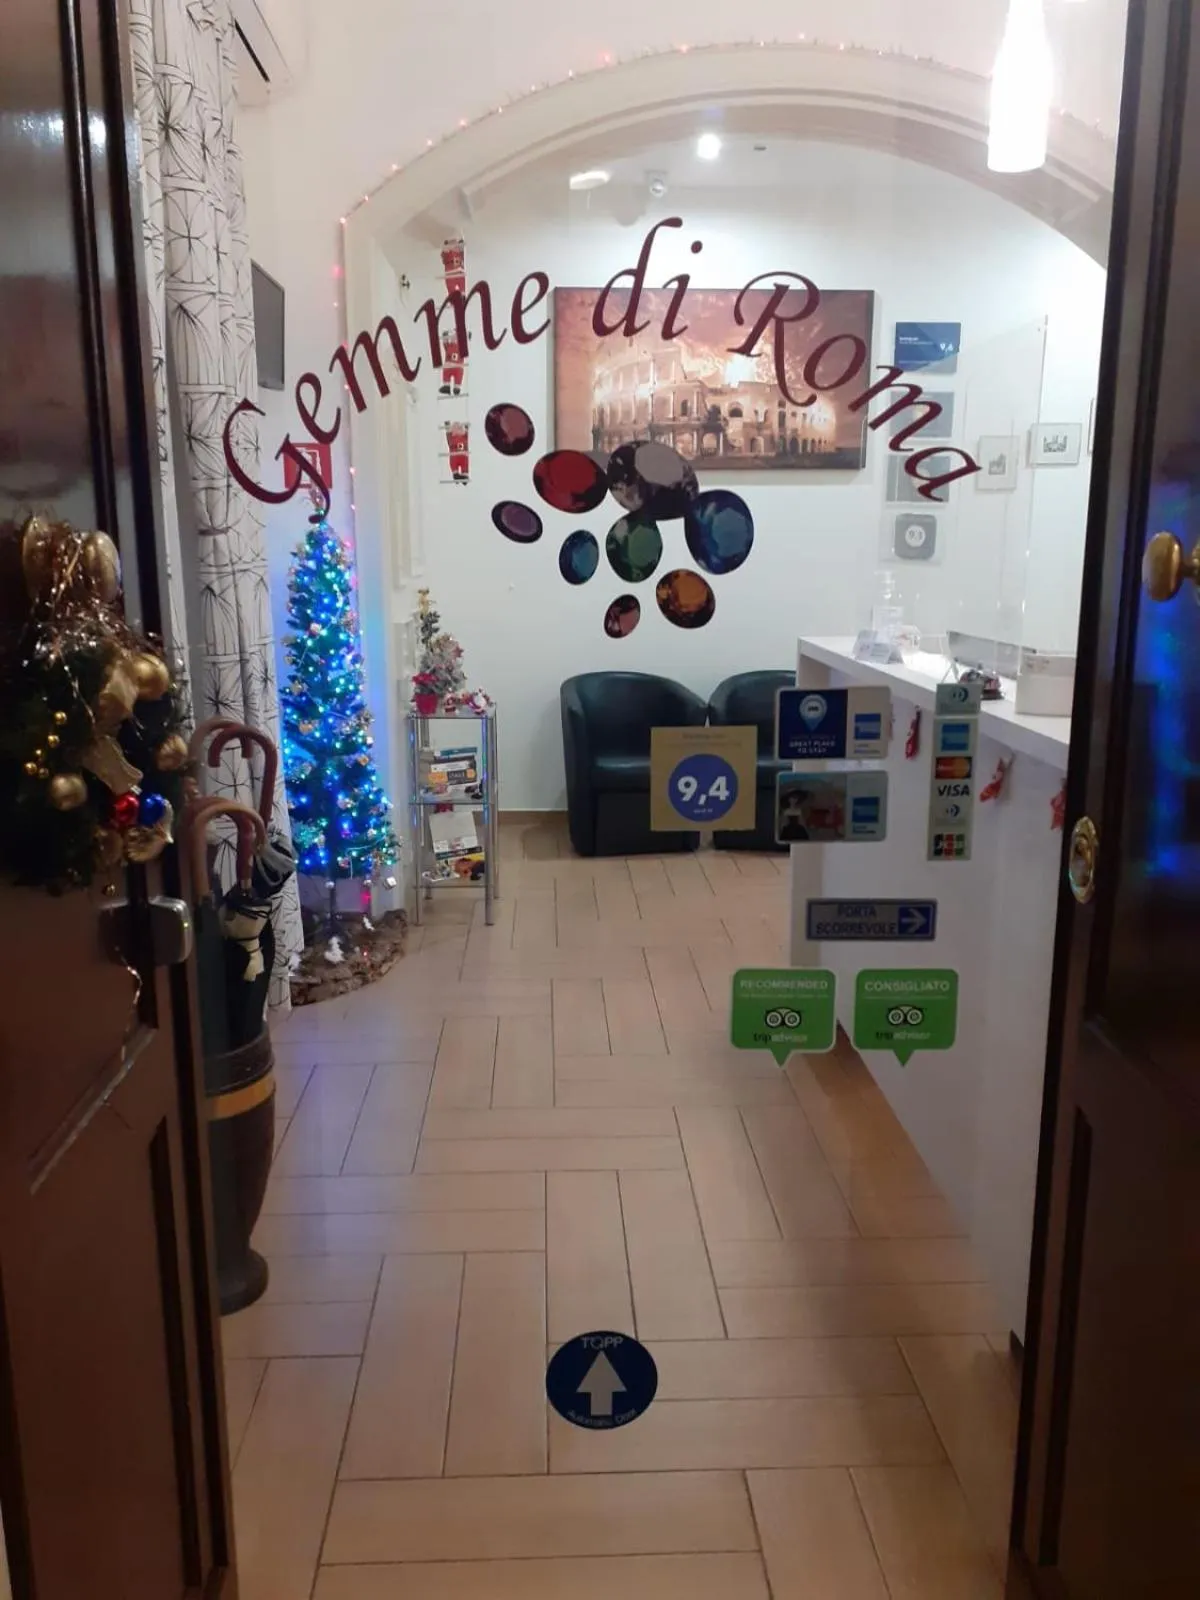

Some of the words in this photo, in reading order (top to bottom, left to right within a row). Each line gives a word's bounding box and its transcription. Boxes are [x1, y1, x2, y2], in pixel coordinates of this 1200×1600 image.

[223, 271, 551, 524] Gemme
[591, 216, 704, 341] di
[727, 271, 983, 502] Roma
[677, 775, 730, 805] 9,4
[937, 784, 971, 797] VISA
[816, 922, 898, 935] SCORREVOLE
[739, 979, 829, 990] RECOMMENDED
[864, 980, 950, 992] CONSIGLIATO
